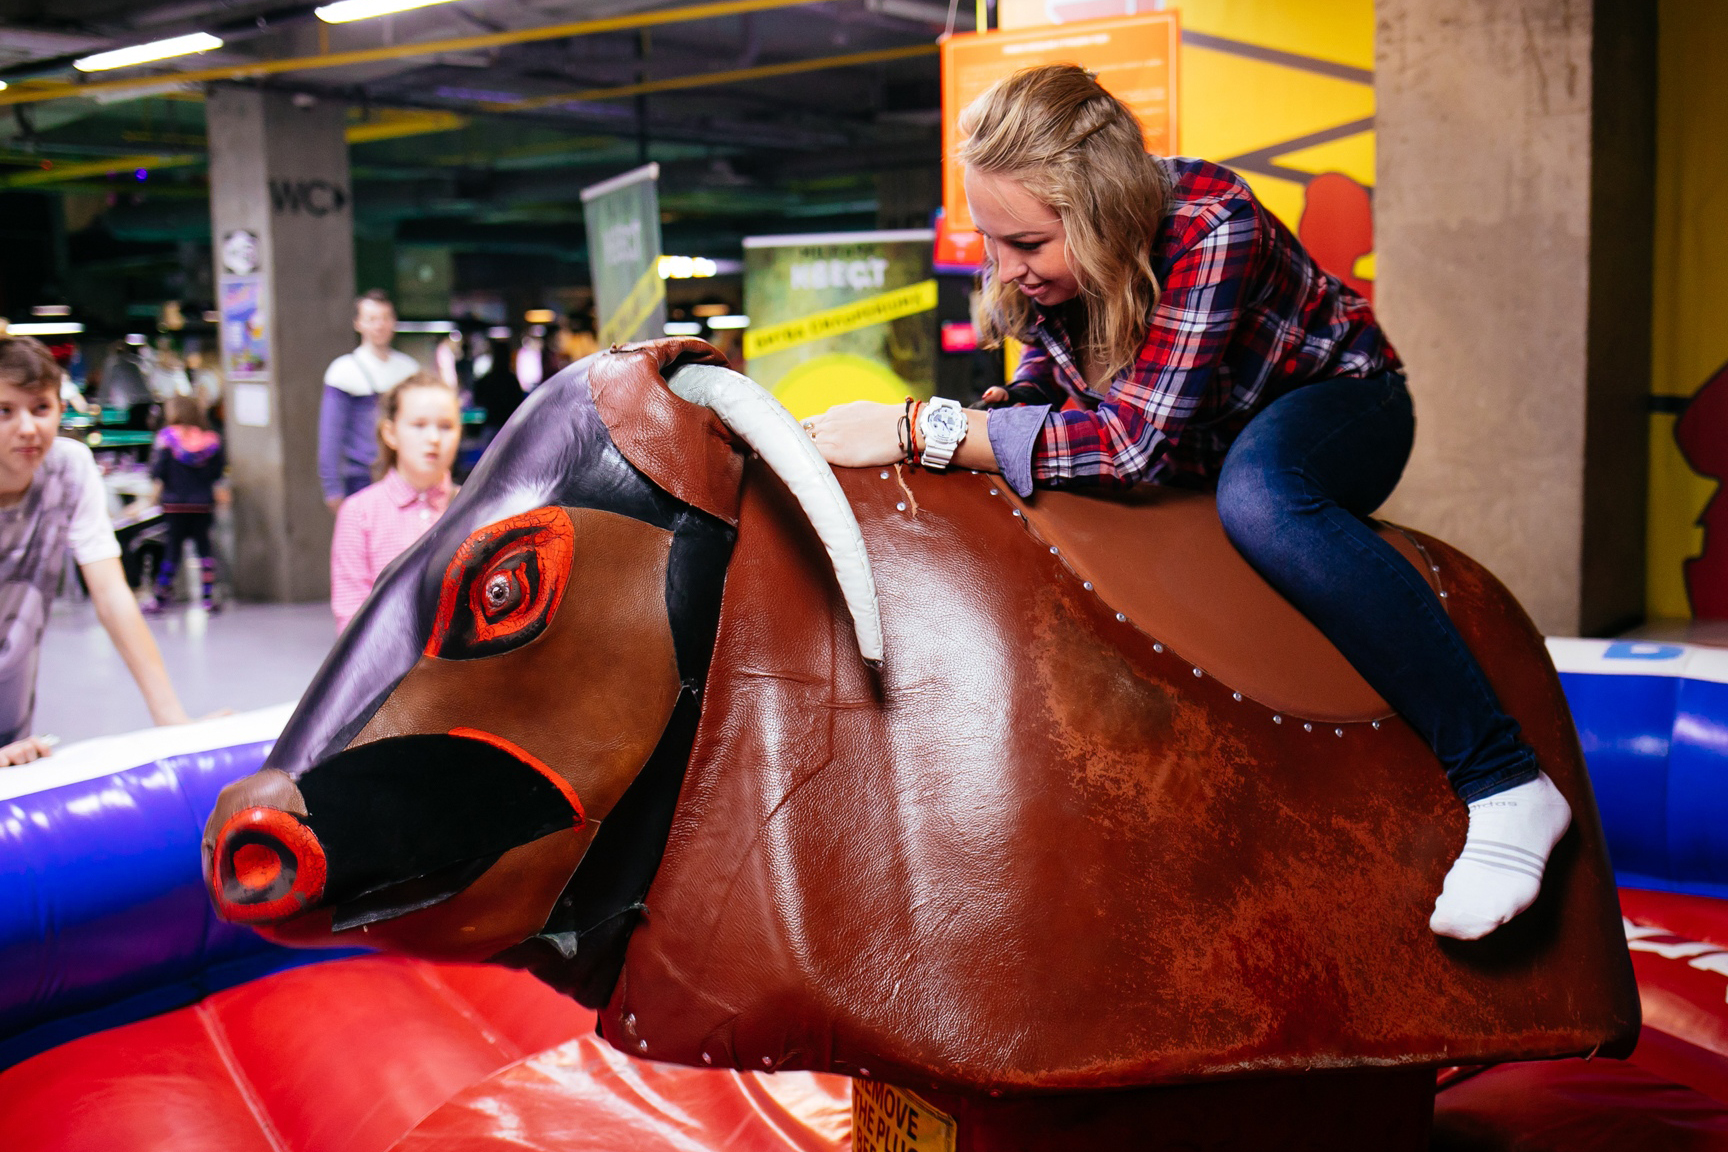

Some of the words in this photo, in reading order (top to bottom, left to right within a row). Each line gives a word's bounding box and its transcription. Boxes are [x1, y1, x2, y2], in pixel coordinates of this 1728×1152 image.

[269, 178, 335, 217] WC
[853, 1083, 875, 1136] THE
[876, 1115, 919, 1152] PLU
